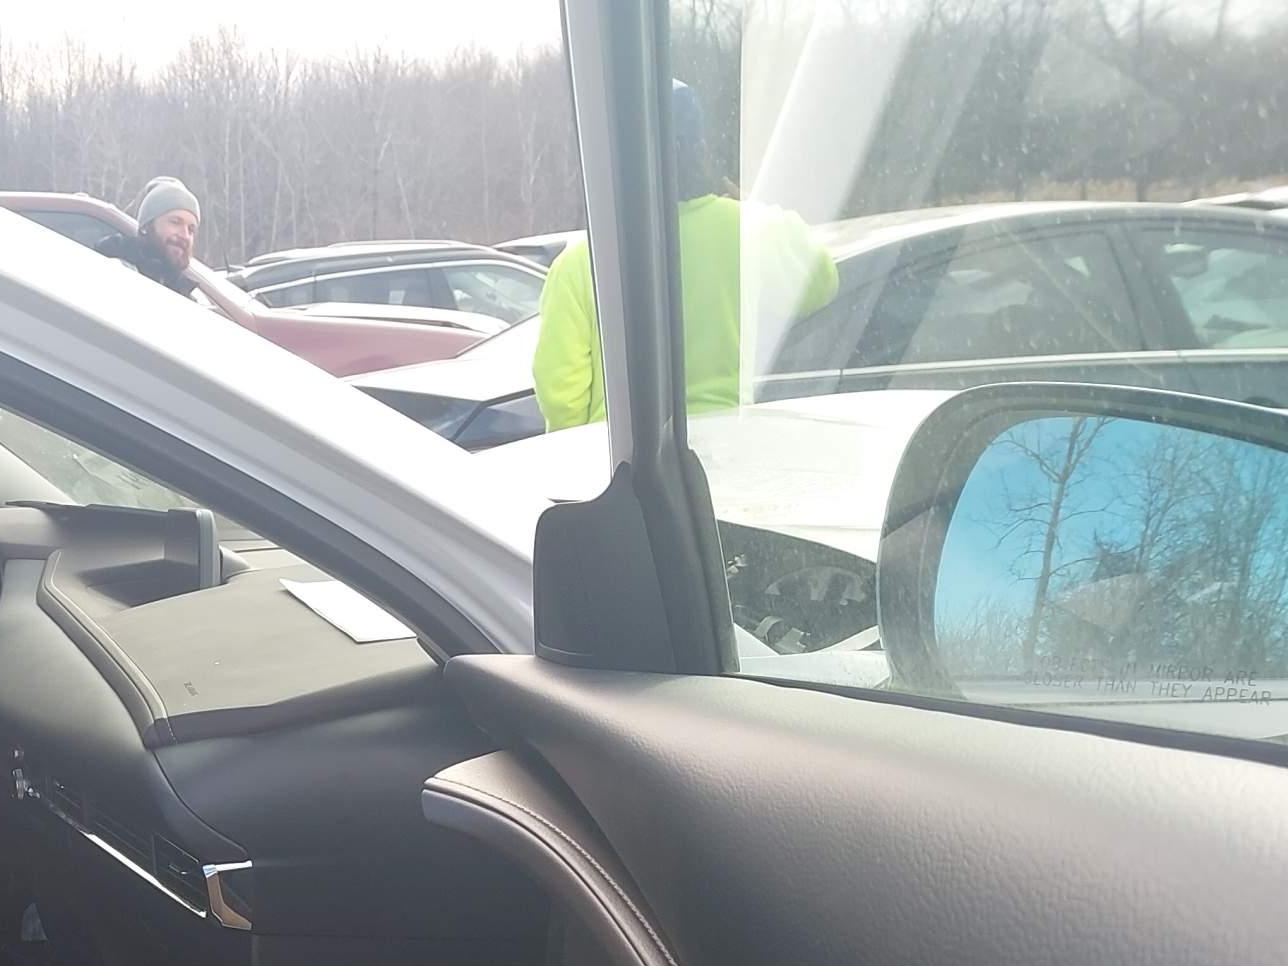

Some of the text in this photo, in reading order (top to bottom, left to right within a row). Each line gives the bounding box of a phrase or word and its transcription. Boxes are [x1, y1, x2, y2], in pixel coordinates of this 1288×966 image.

[1023, 671, 1272, 706] CLOSER THAN THEY APPEAR
[1150, 664, 1214, 682] MIRROR
[1223, 670, 1258, 687] ARE
